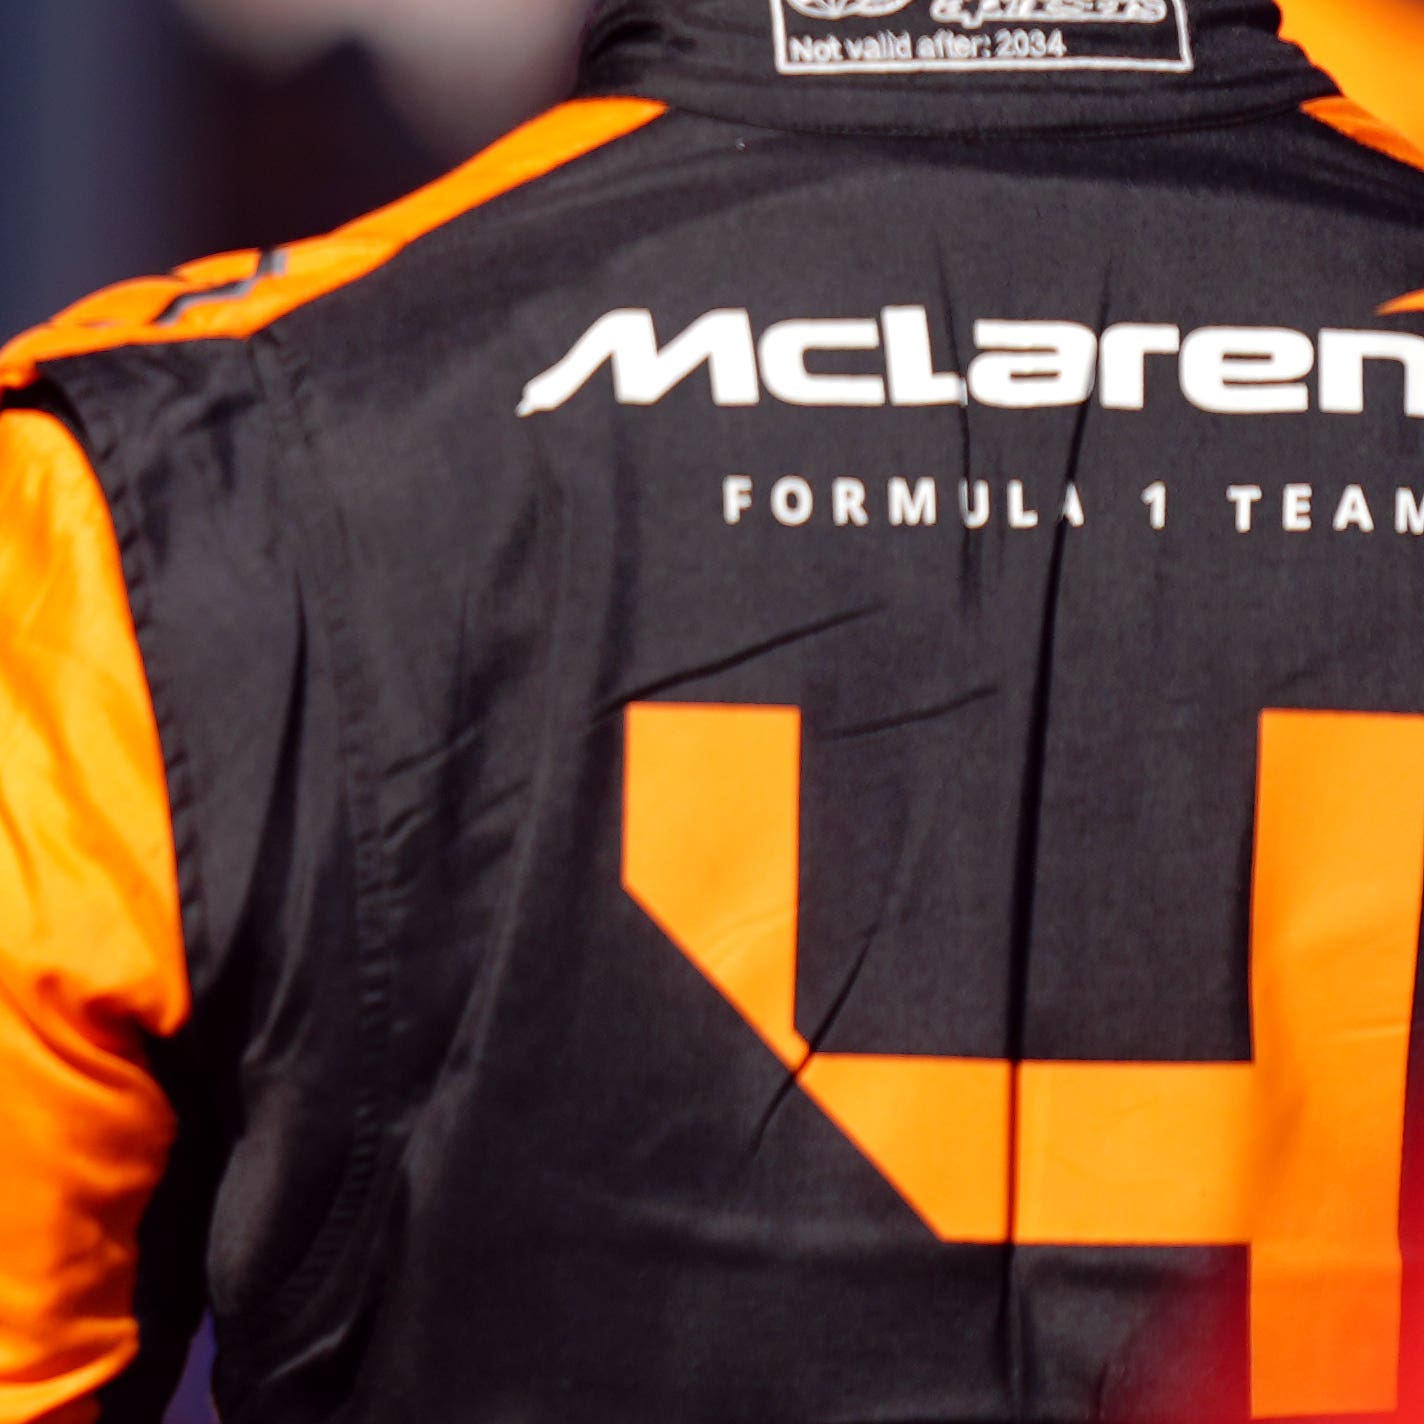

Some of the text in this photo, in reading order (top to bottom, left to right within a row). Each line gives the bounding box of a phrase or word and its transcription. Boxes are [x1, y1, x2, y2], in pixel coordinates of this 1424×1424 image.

[789, 33, 844, 62] Not
[844, 29, 913, 60] valid
[994, 27, 1068, 58] 2034
[515, 304, 1424, 418] McLaren
[1141, 481, 1167, 530] 1
